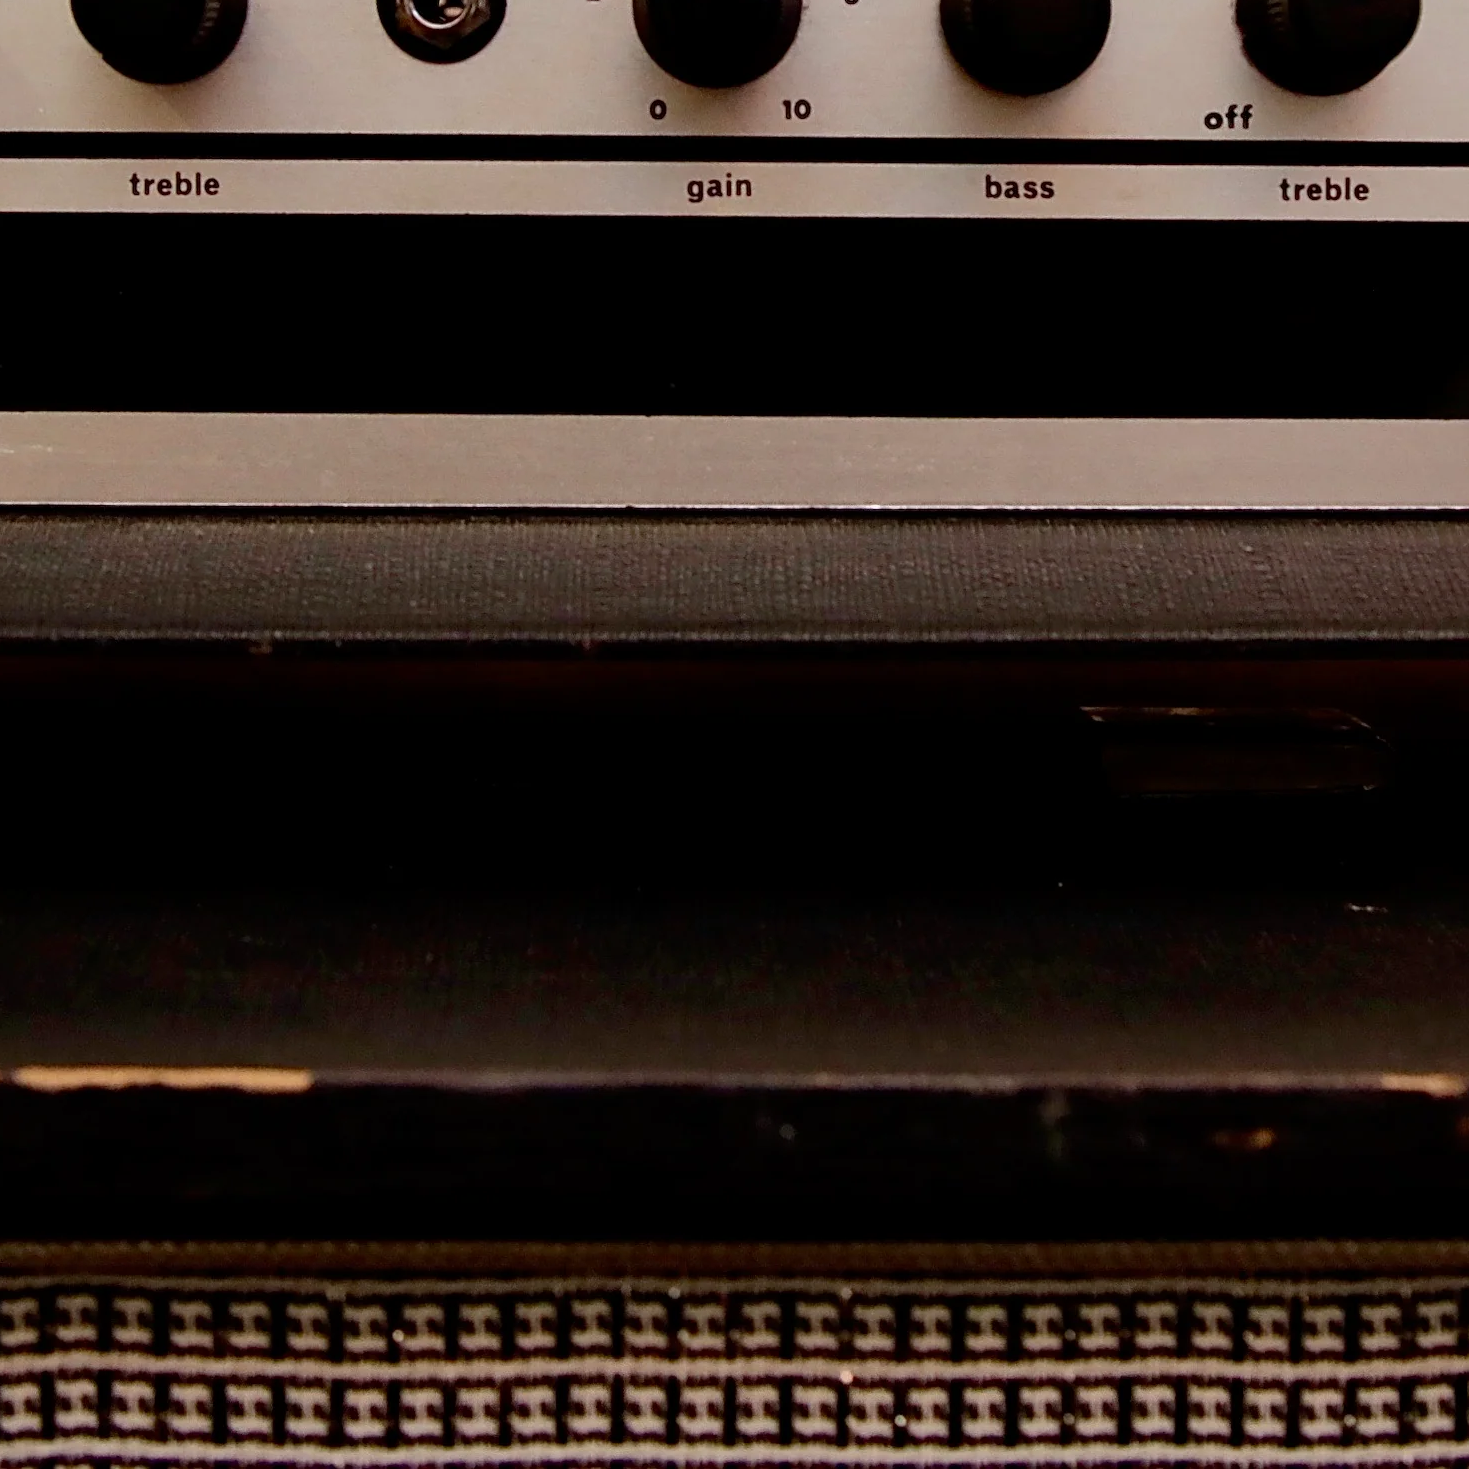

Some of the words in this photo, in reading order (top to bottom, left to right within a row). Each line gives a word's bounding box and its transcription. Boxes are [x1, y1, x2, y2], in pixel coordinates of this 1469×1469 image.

[649, 98, 668, 121] 0
[782, 98, 812, 120] 10
[1204, 103, 1254, 130] off
[128, 171, 220, 197] treble
[686, 172, 752, 201] gain
[985, 173, 1055, 200] bass
[1279, 176, 1370, 202] treble
